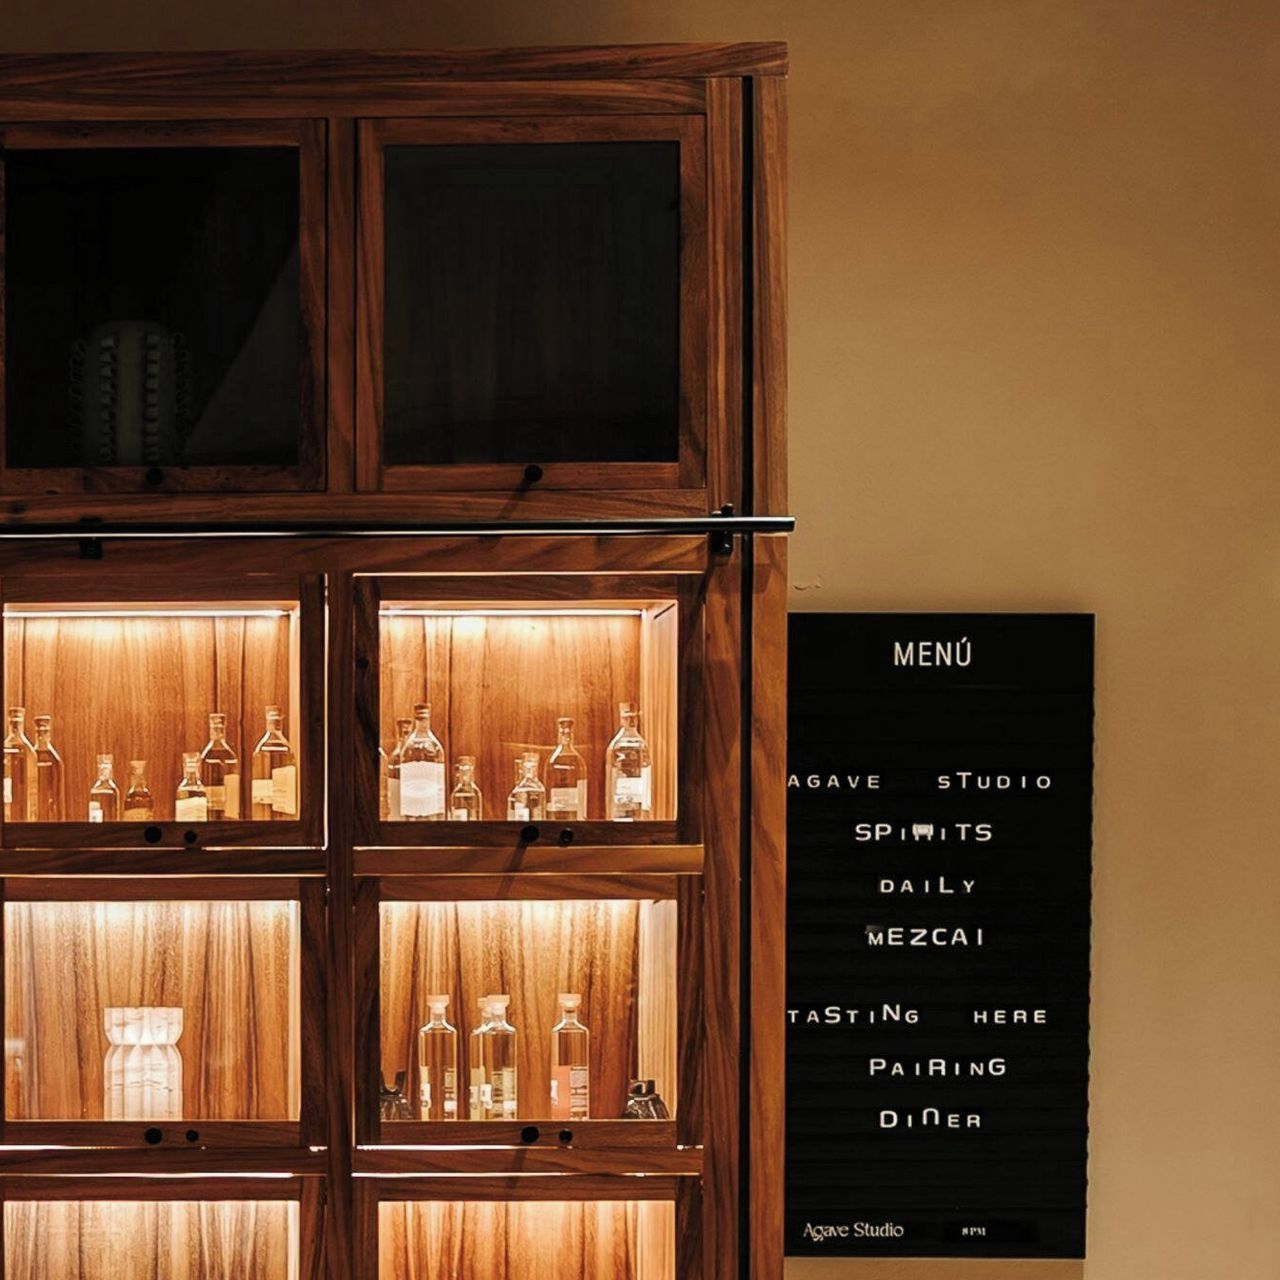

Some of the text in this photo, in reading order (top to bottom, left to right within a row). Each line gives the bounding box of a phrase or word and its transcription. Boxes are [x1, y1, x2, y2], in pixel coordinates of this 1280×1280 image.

[894, 636, 971, 667] MENÚ
[788, 771, 1051, 790] AGAVE STUDIO
[880, 876, 975, 894] DAILY
[788, 1003, 1047, 1024] TASTING HERE
[869, 1058, 1006, 1077] PAIRING
[803, 1222, 904, 1242] Agave Studio
